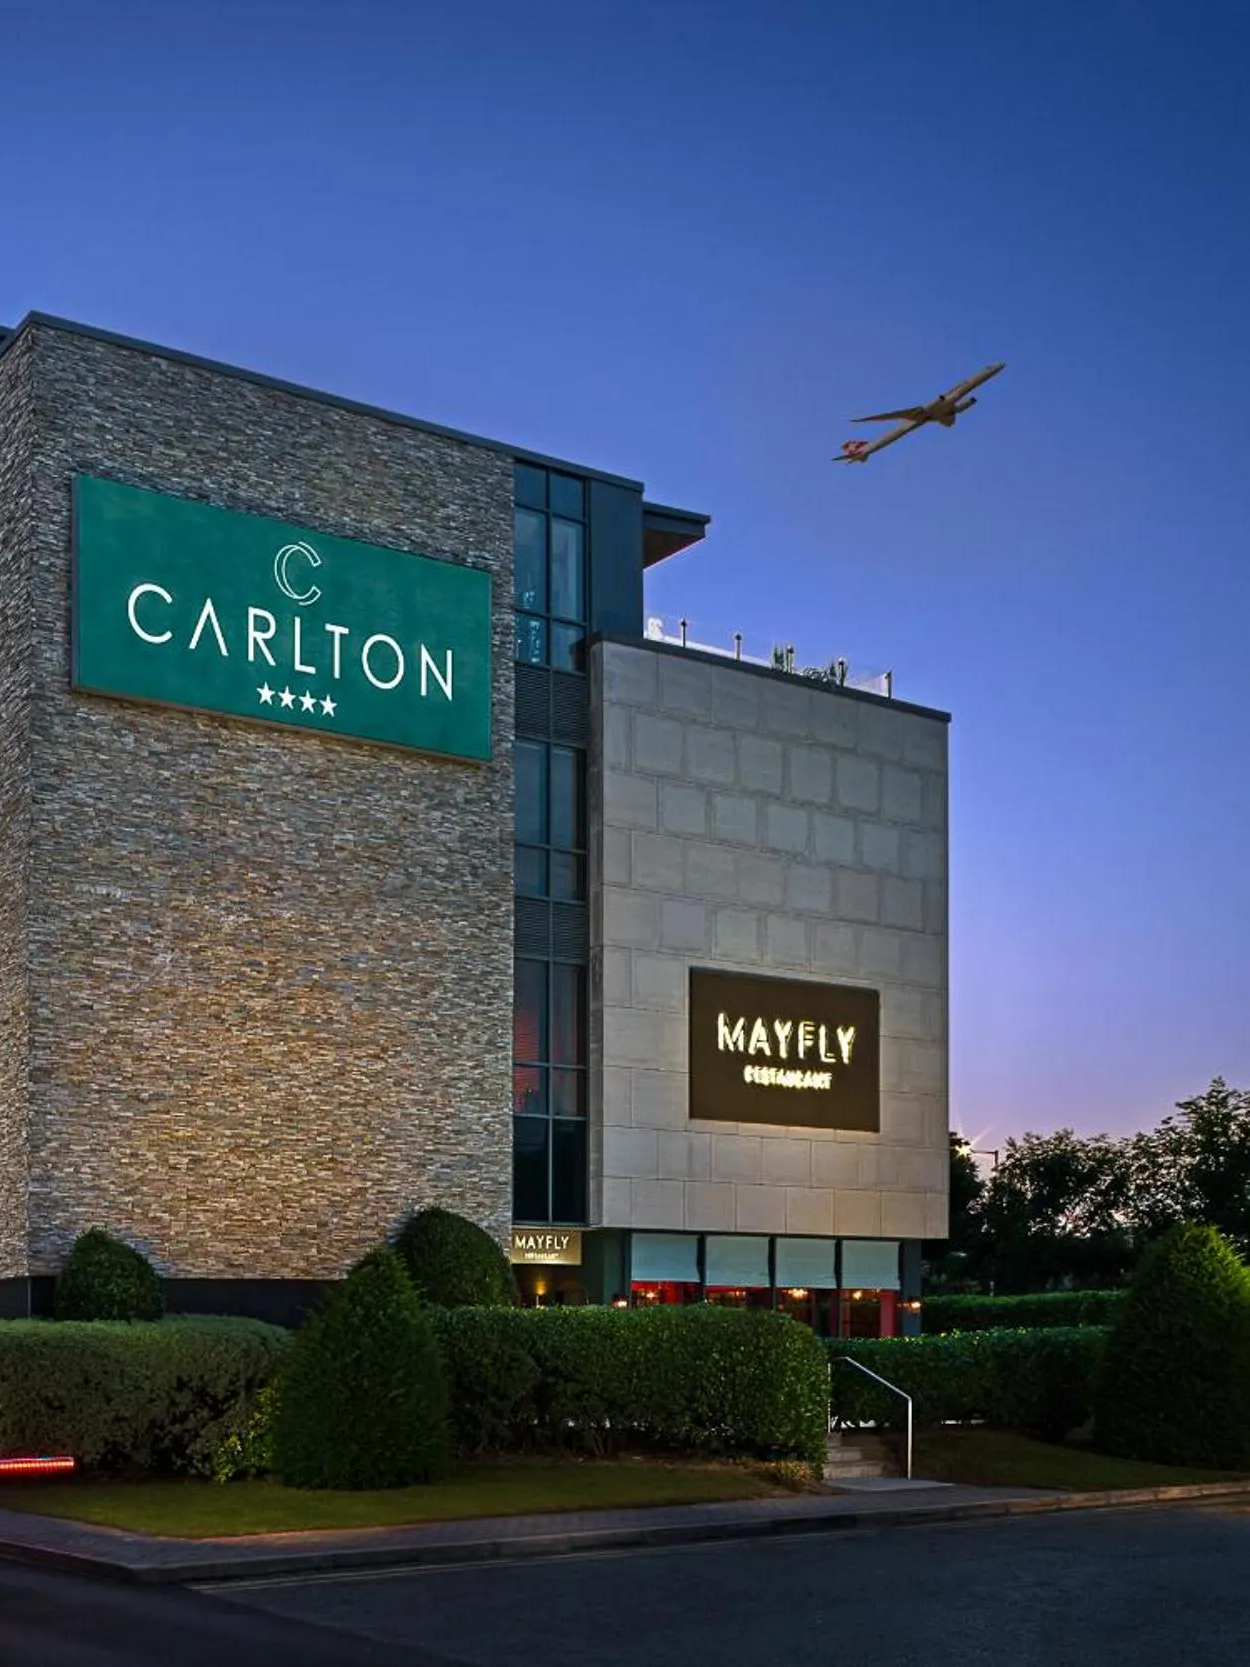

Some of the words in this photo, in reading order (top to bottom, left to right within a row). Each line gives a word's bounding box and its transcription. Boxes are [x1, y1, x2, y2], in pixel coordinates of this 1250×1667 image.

[128, 583, 453, 701] CARLTON
[717, 1011, 856, 1064] MAYFLY
[514, 1235, 570, 1249] MAYFLY
